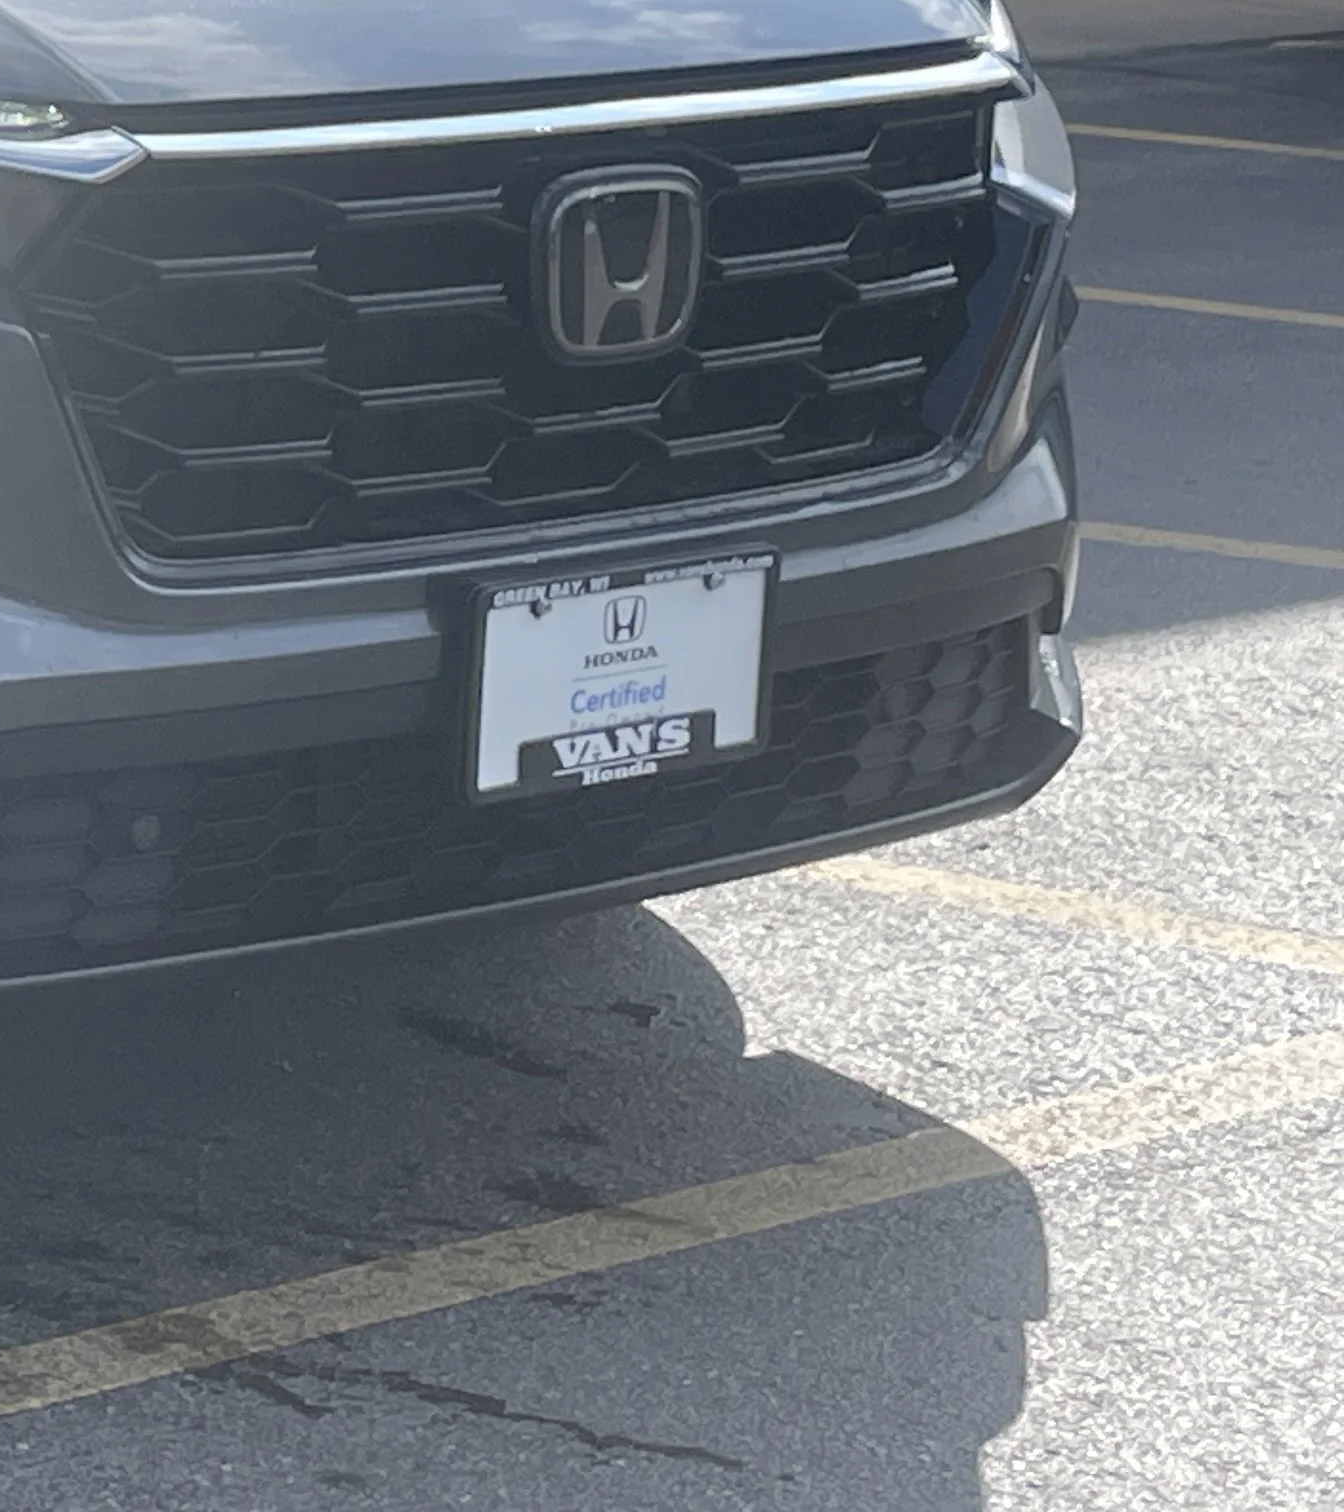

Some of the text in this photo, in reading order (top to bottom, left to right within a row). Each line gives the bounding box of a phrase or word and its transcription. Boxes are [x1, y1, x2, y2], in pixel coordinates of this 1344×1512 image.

[583, 645, 659, 669] HONDA
[570, 674, 667, 714] Certified
[581, 759, 658, 786] Honda
